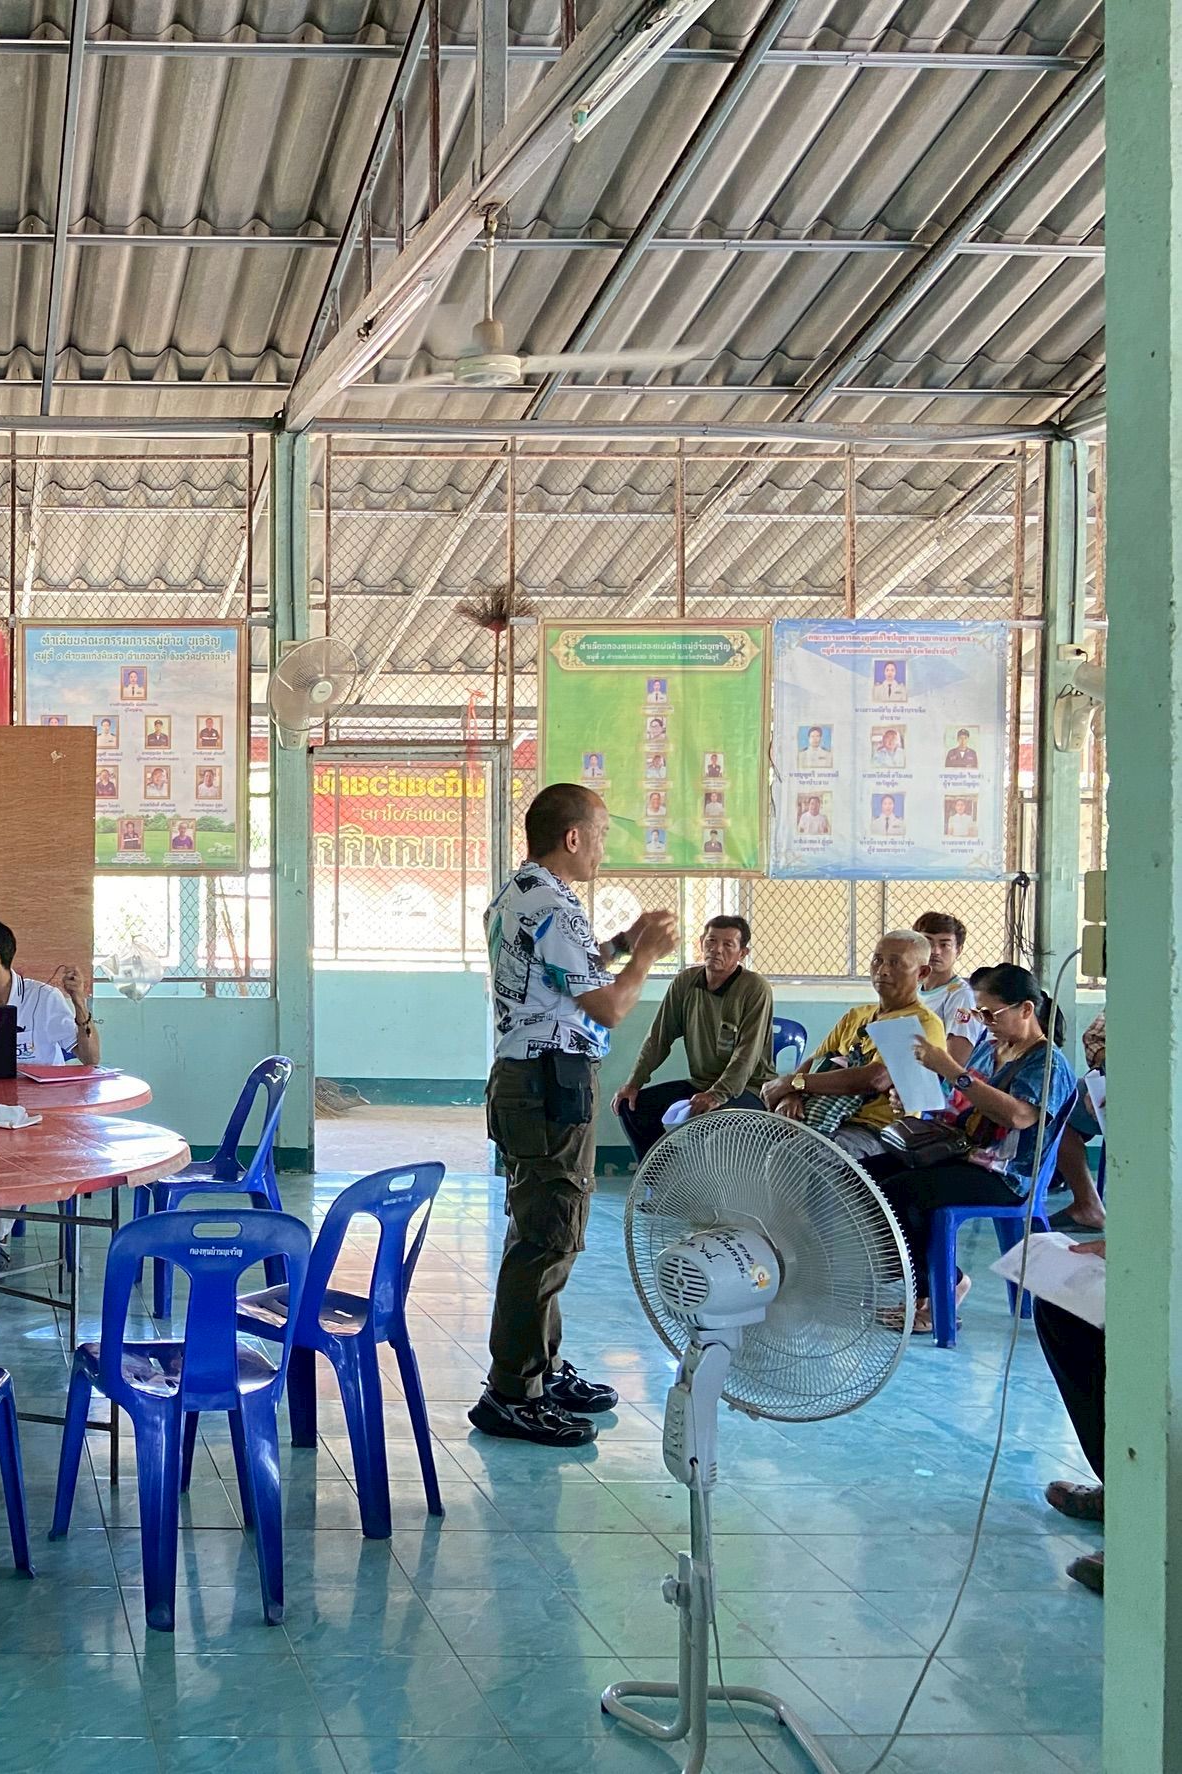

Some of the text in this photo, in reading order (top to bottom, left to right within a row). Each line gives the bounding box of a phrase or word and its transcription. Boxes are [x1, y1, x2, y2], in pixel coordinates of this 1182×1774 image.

[41, 633, 183, 650] ทำเนียบคณะกรรมการหมู่บ้าน
